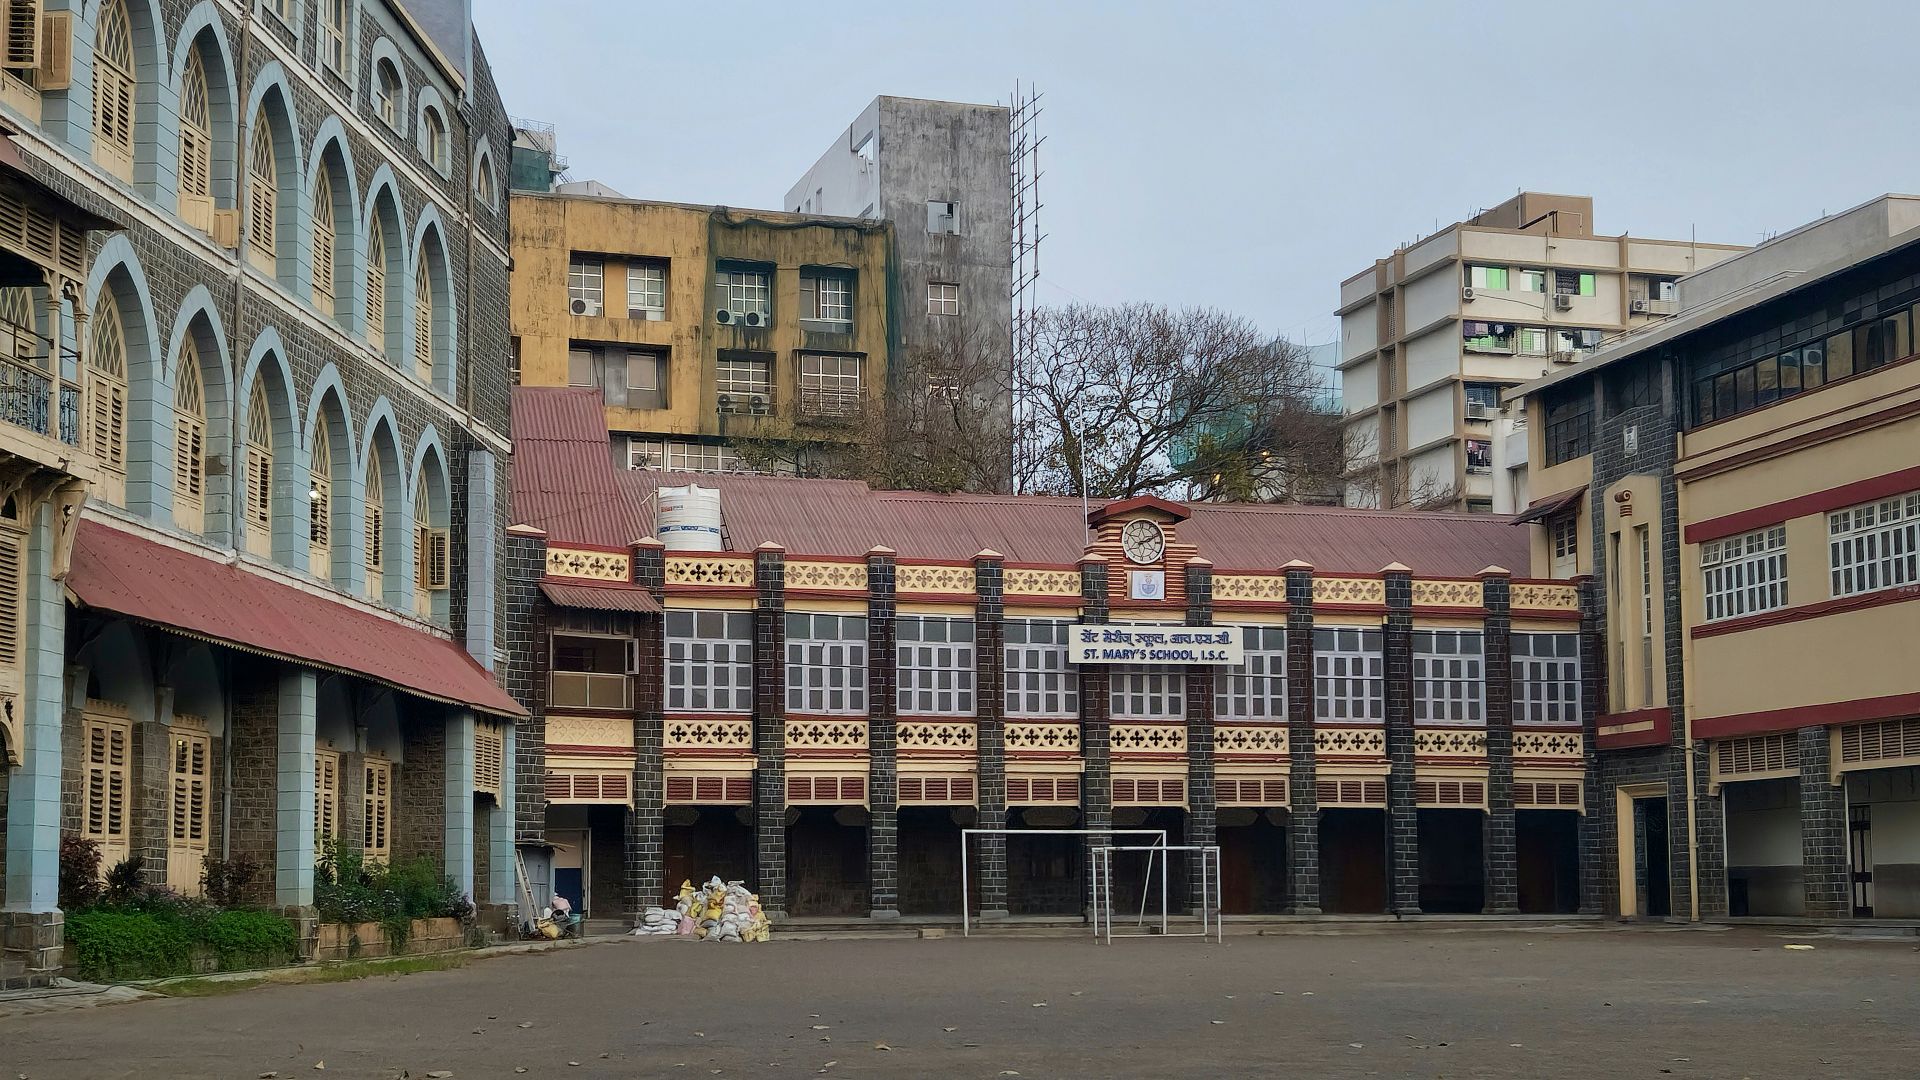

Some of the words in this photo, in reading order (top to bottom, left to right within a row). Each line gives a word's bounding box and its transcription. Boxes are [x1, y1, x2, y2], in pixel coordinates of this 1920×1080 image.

[1084, 649, 1099, 660] ST.
[1103, 649, 1146, 660] MARY'S
[1150, 650, 1198, 662] SCHOOL,
[1201, 650, 1229, 661] I.S.C.
